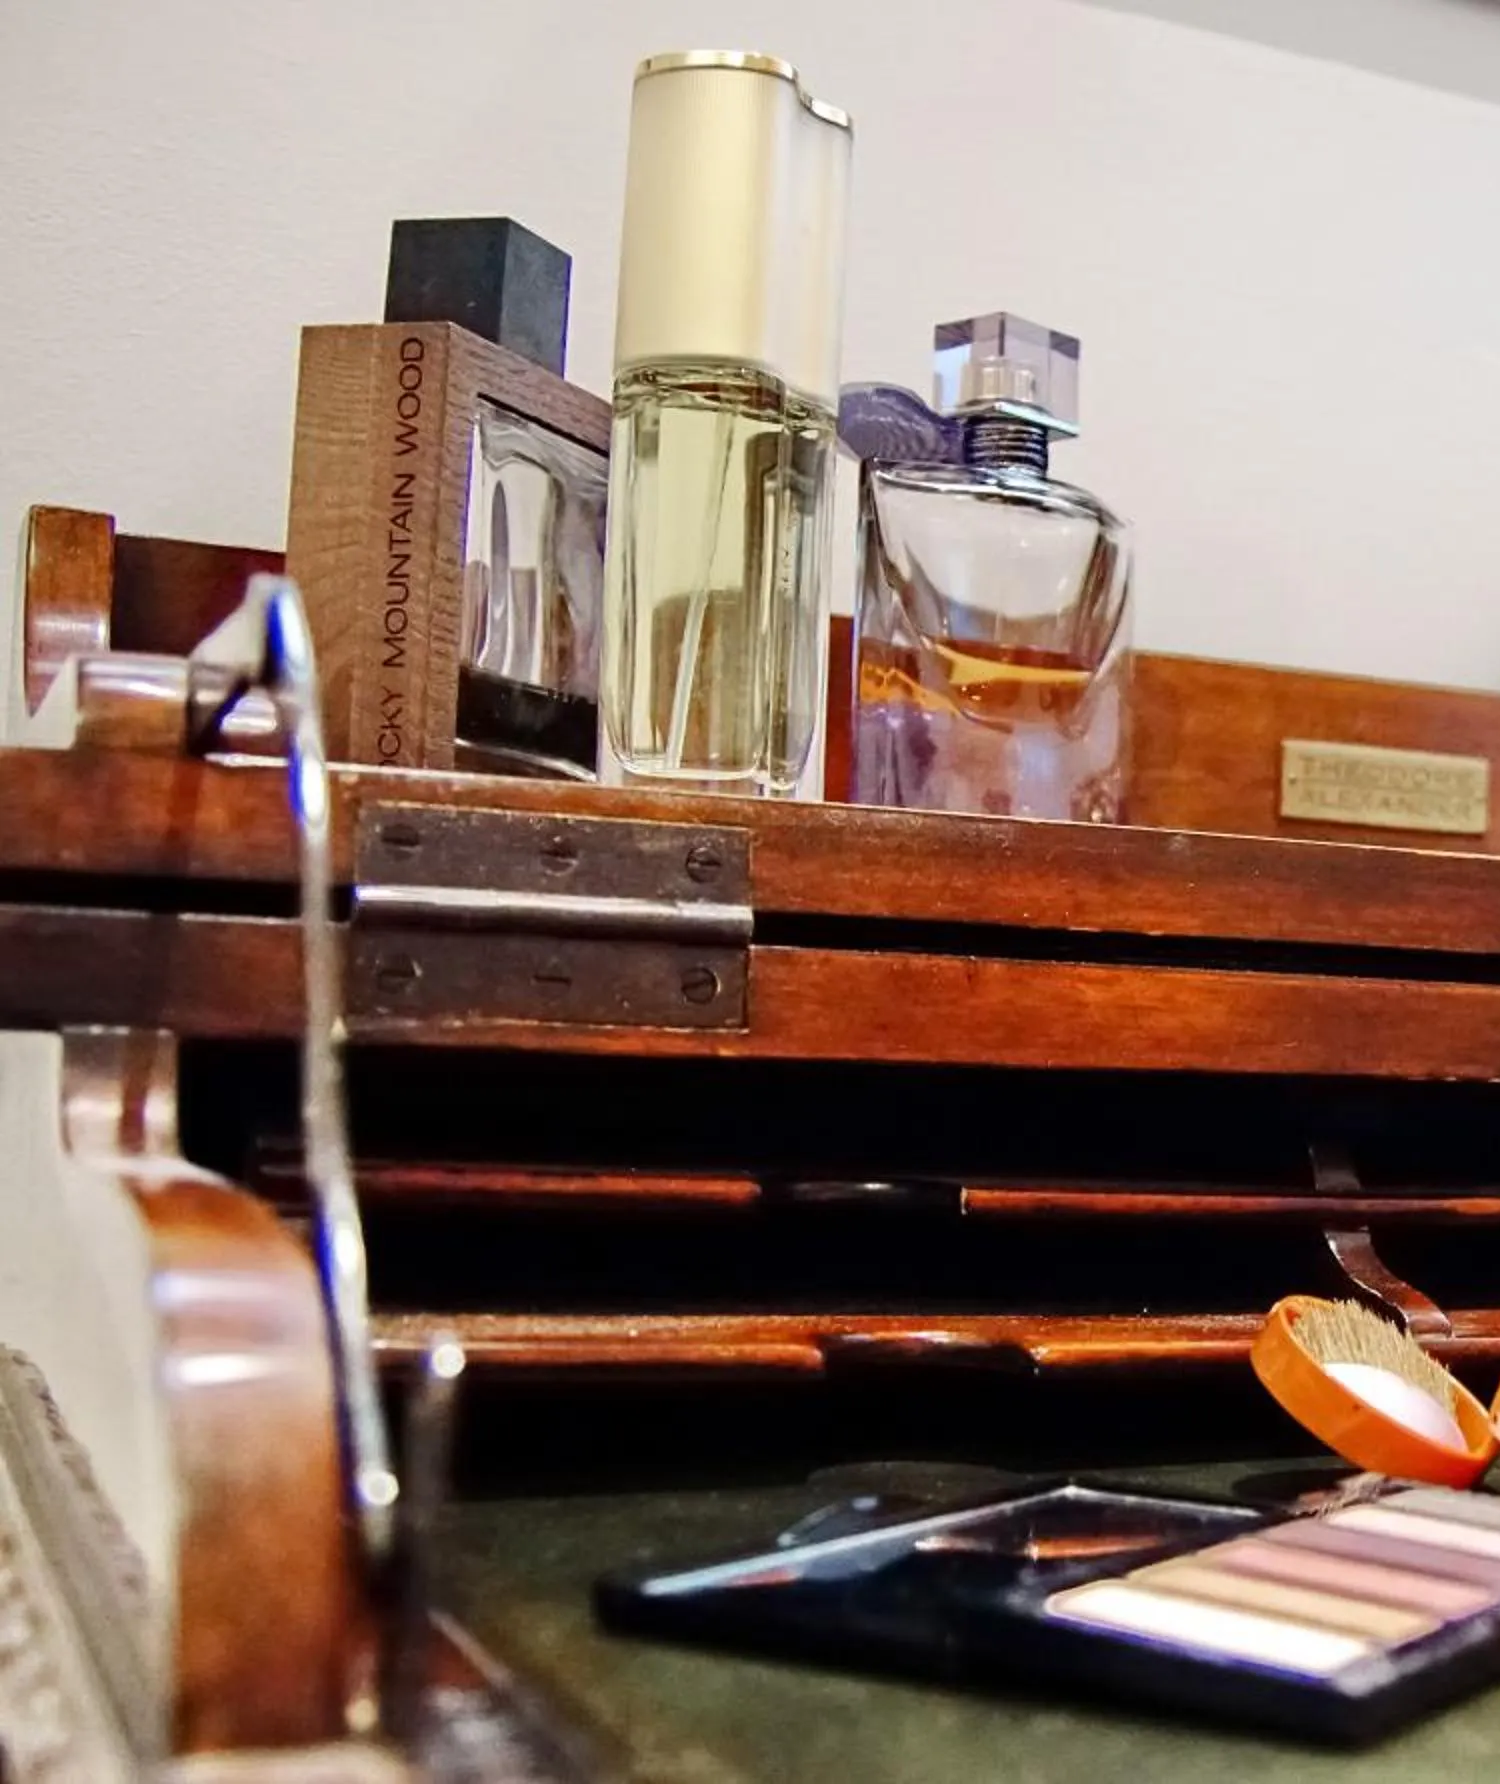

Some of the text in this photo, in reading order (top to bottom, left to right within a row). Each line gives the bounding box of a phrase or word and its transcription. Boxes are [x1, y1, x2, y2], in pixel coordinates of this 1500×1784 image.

[376, 337, 424, 767] CKY MOUNTAIN WOOD
